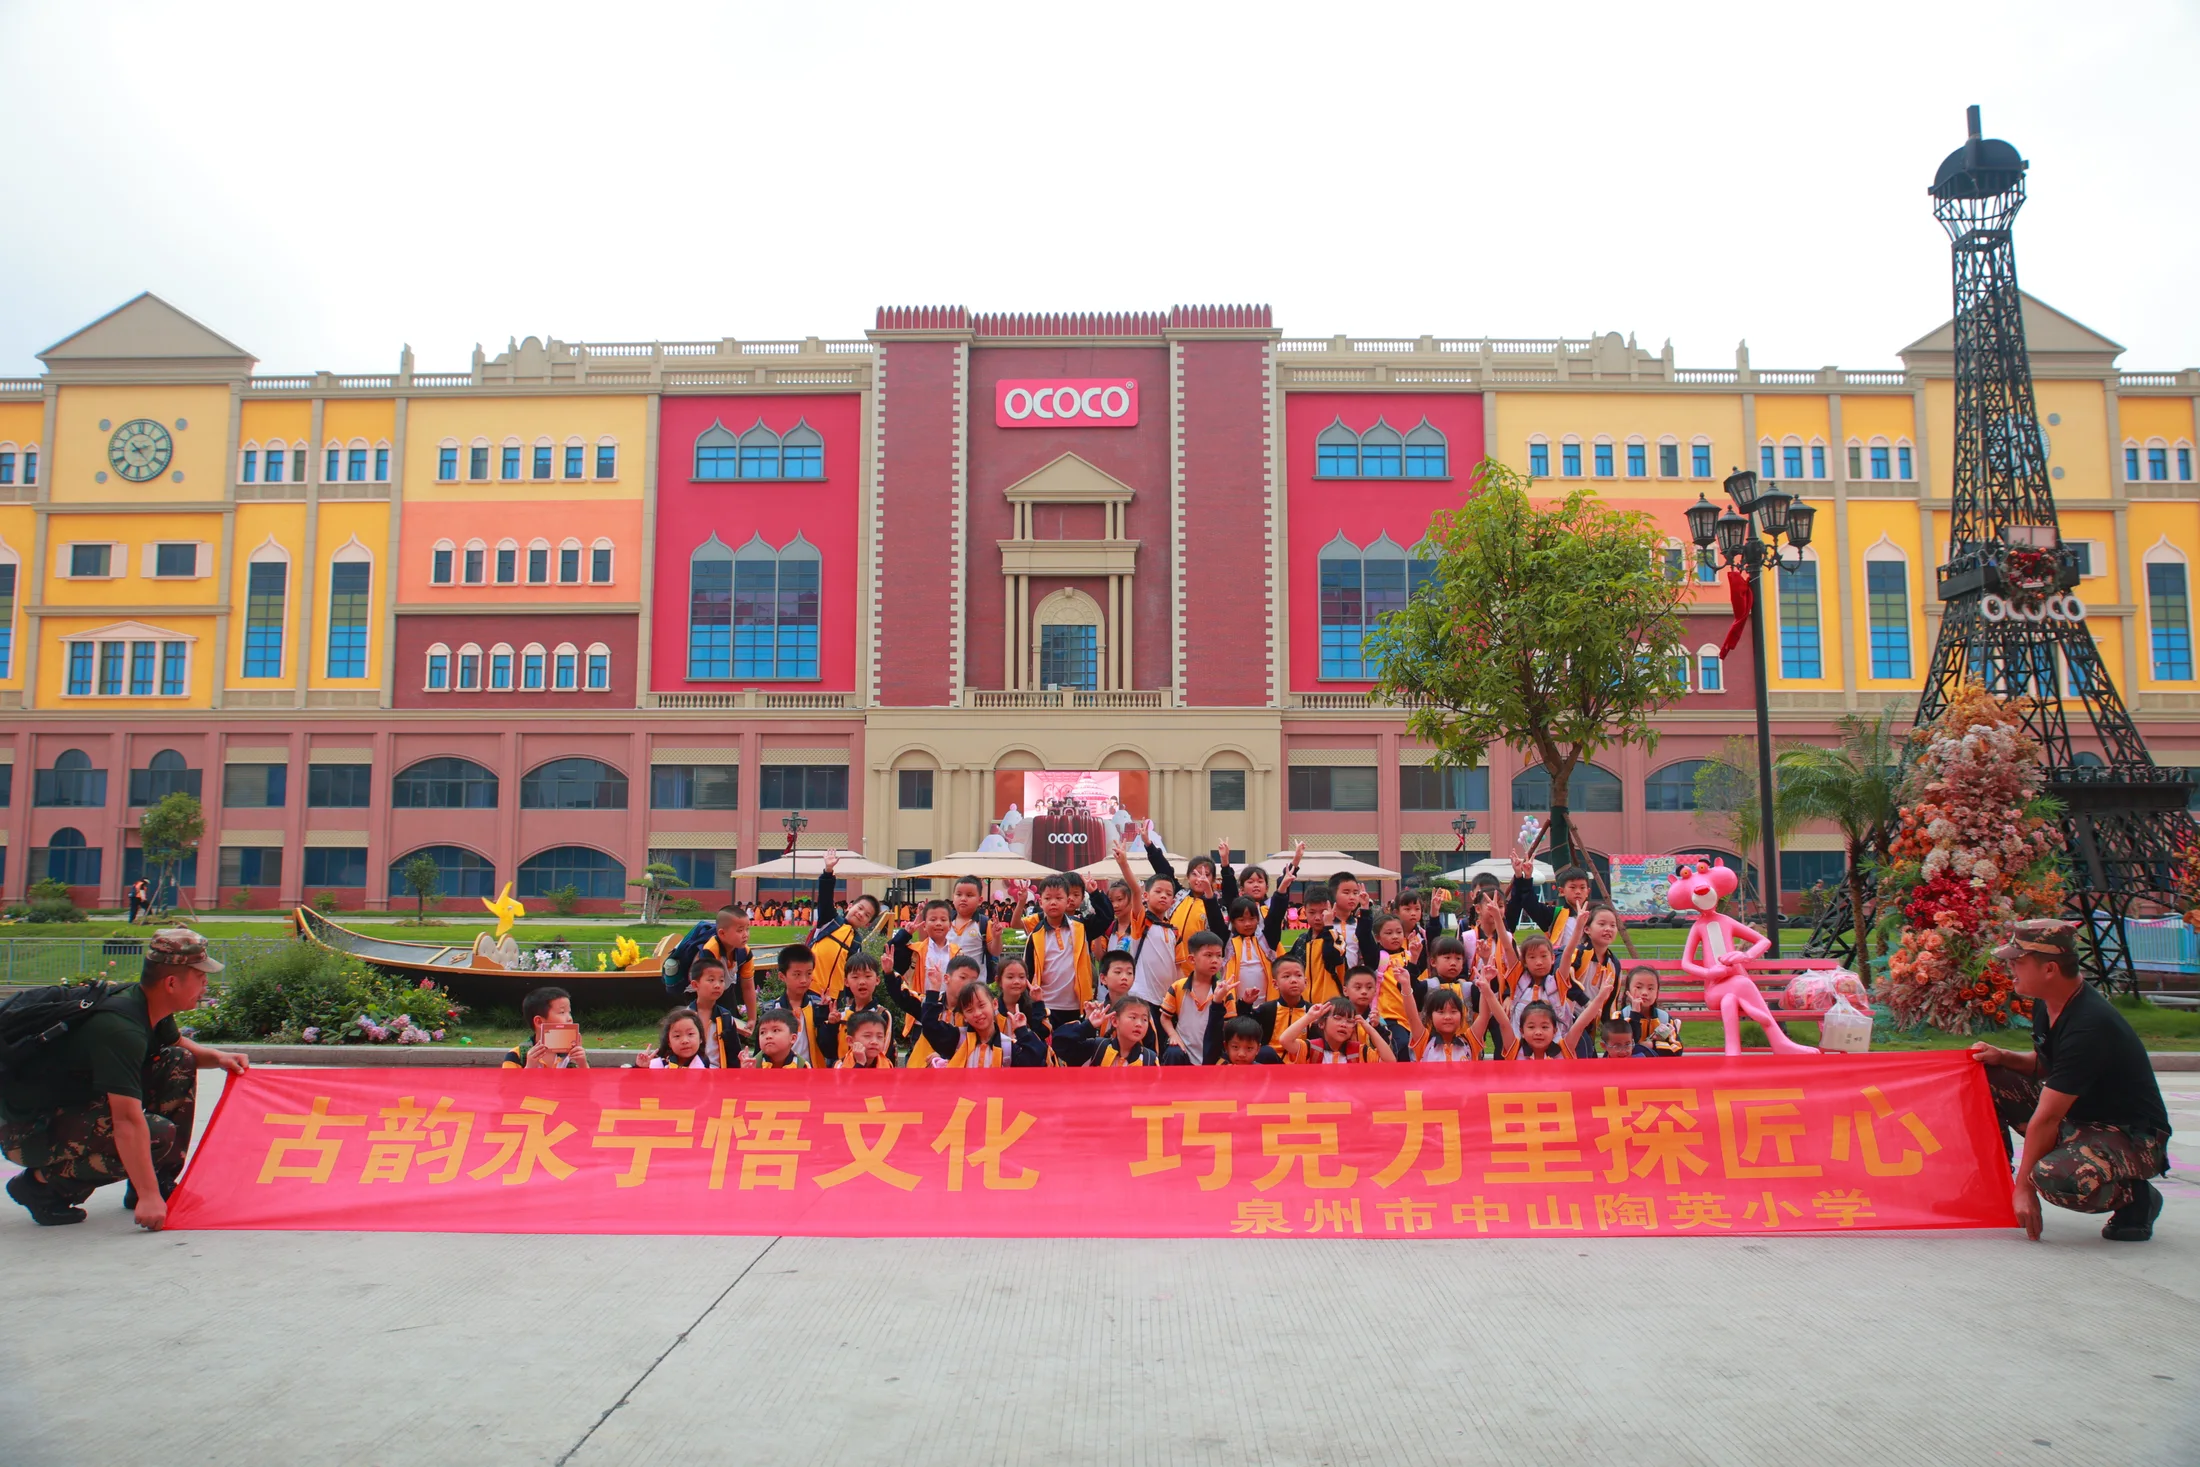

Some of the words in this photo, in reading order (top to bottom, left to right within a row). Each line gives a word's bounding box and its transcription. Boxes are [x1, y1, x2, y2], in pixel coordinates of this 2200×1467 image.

[1004, 386, 1130, 420] OCOCO
[1048, 832, 1088, 844] OCOCO
[256, 1095, 1041, 1192] 古韵永宁悟文化
[1128, 1086, 1943, 1192] 巧克力里探匠心
[1229, 1188, 1877, 1234] 泉州市中山陶英小学
